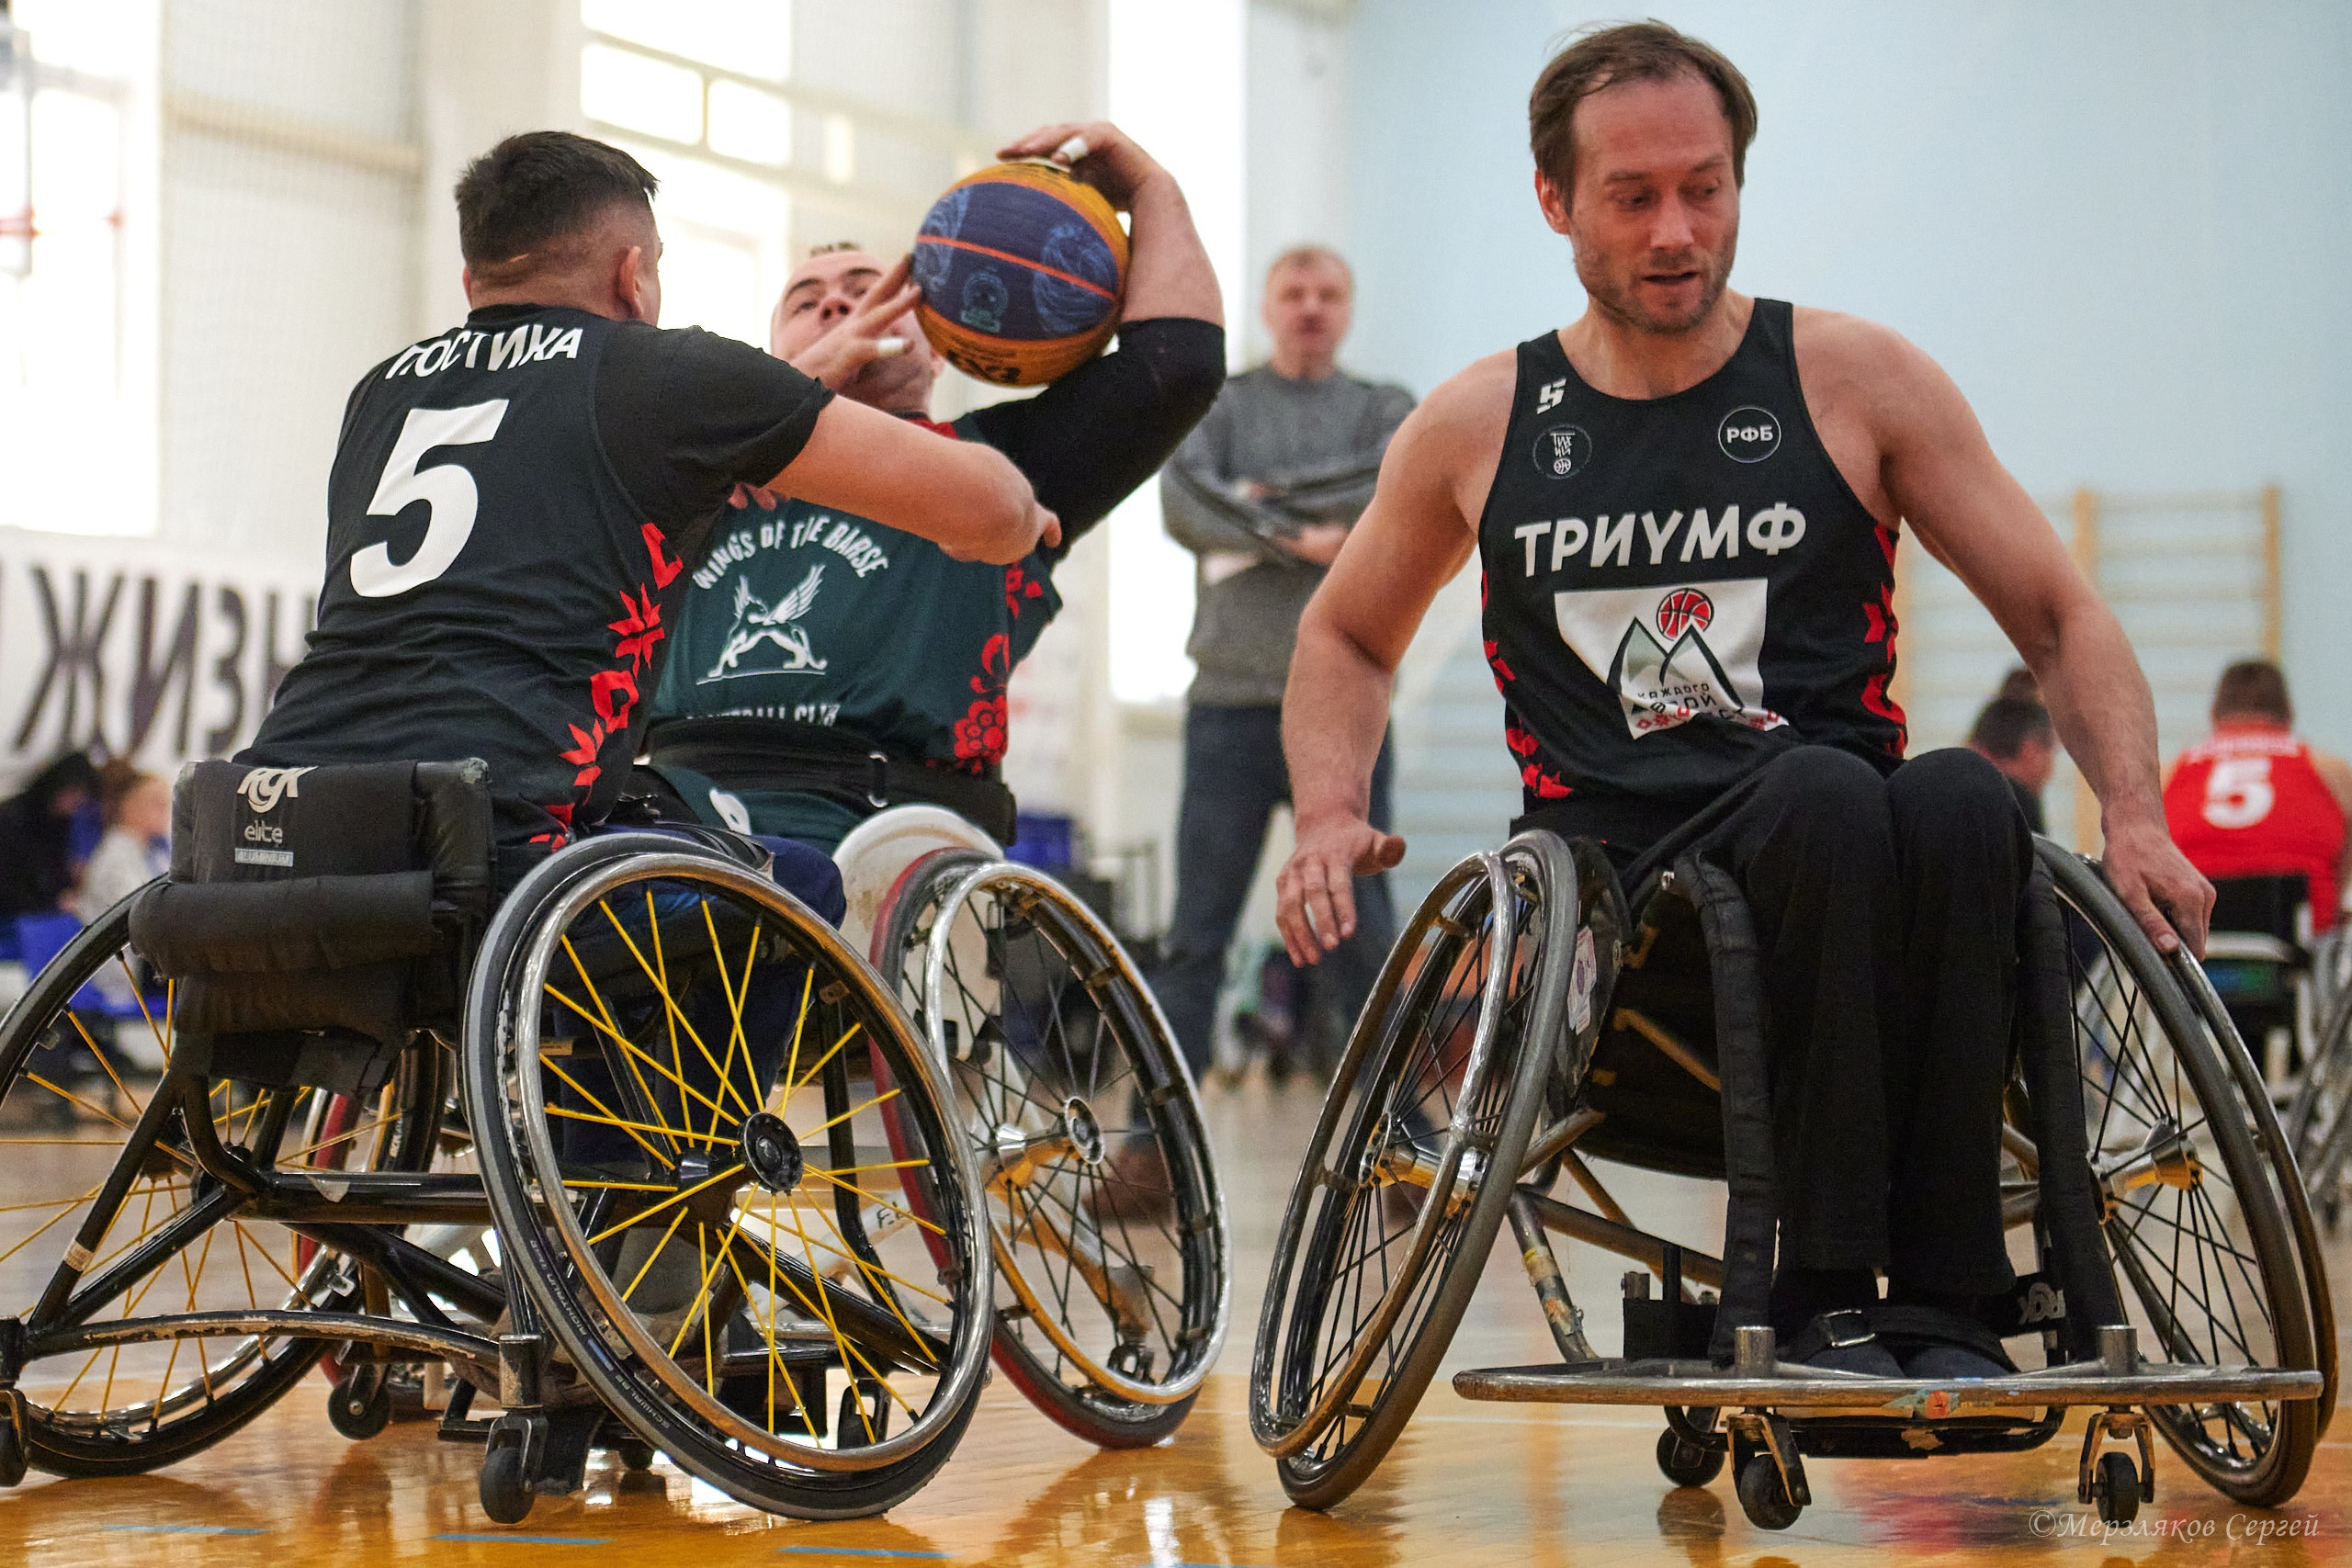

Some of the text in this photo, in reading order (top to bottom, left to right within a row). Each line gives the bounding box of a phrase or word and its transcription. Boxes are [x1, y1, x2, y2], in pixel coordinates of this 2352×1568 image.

[1726, 425, 1774, 444] РФБ
[350, 399, 510, 597] 5
[692, 530, 756, 589] WINGS
[761, 519, 785, 549] OF
[821, 522, 888, 578] BARSE
[1514, 502, 1806, 577] ТРИУМФ
[2202, 757, 2275, 829] 5
[244, 820, 283, 844] elite
